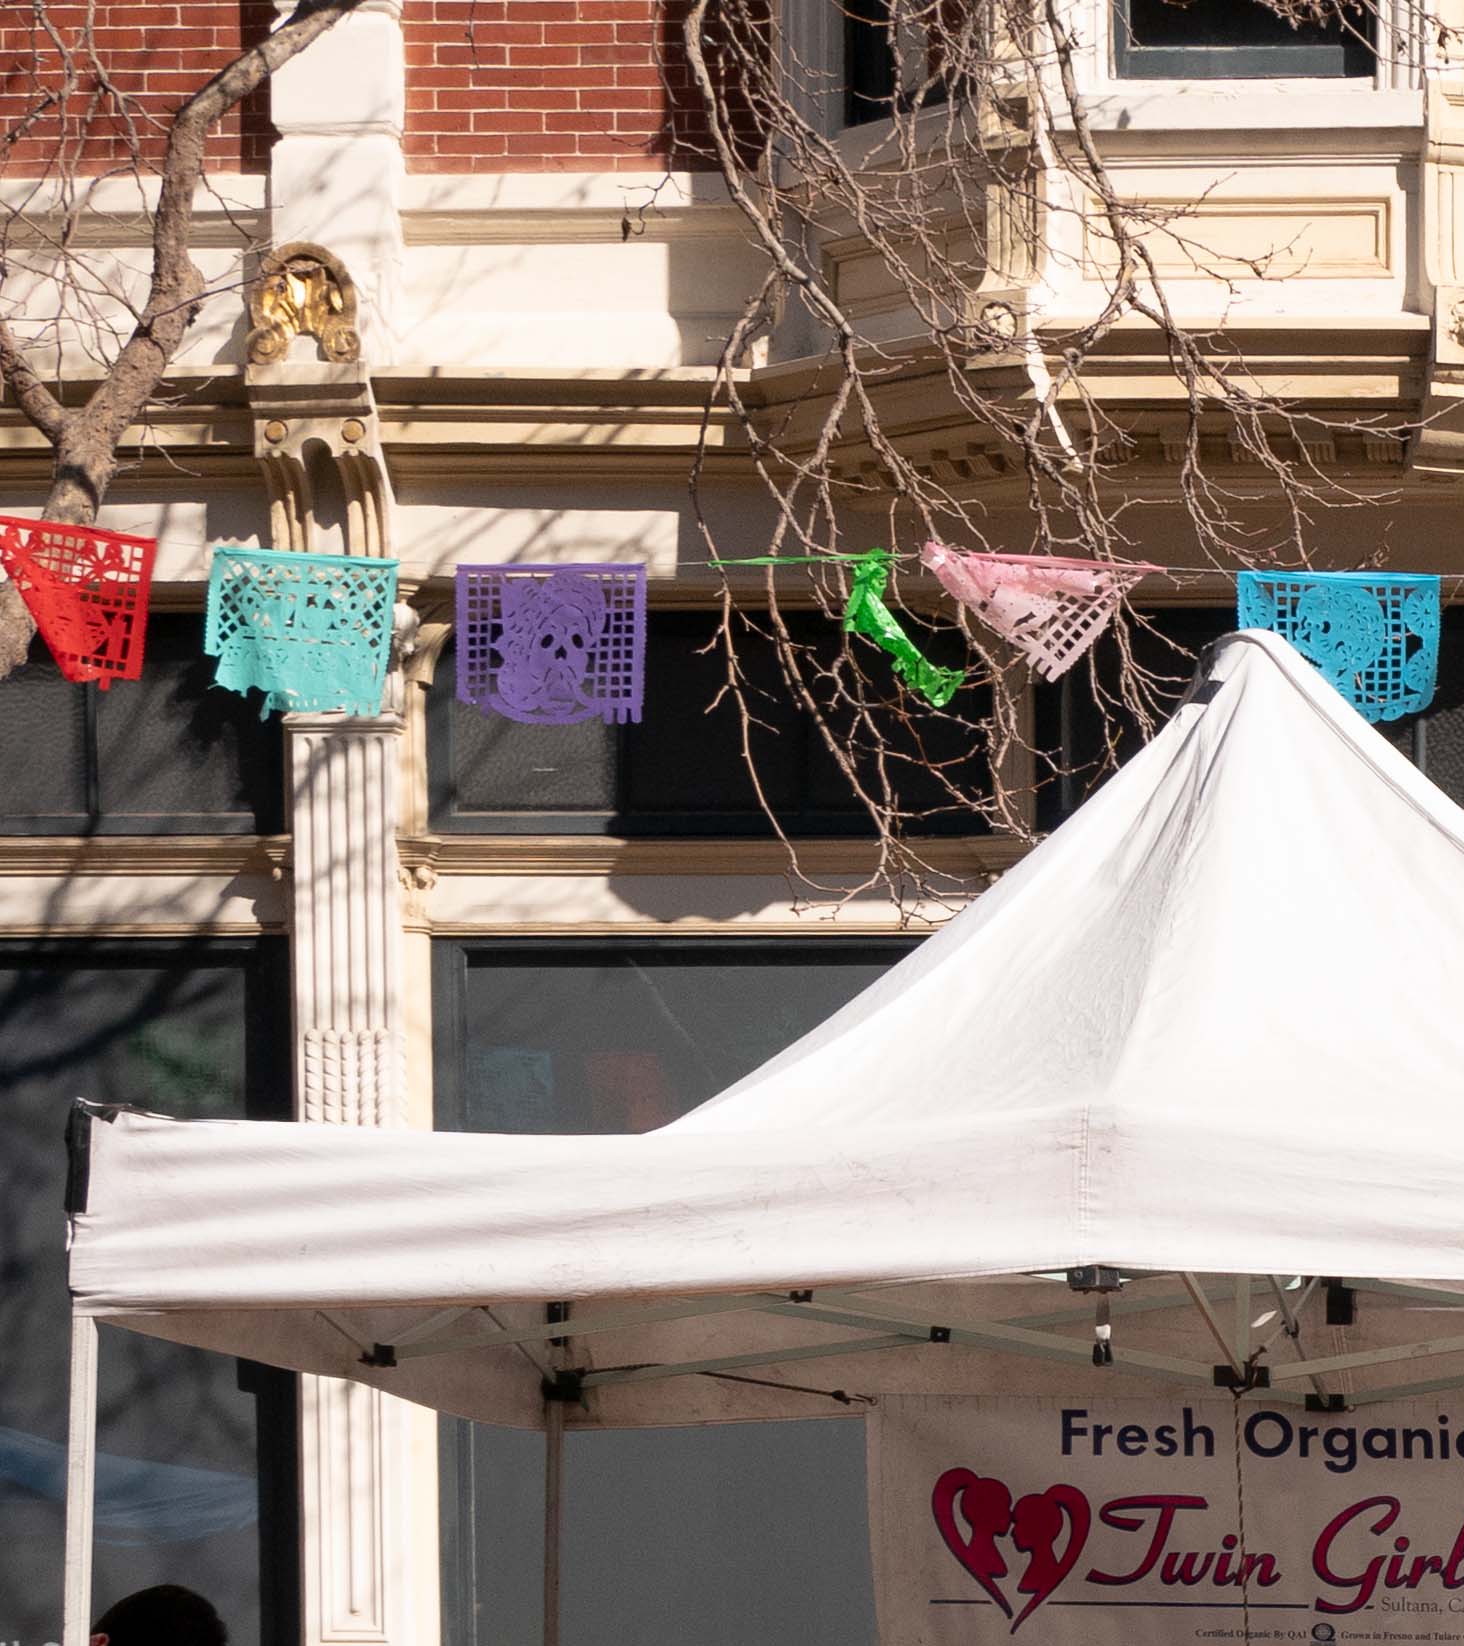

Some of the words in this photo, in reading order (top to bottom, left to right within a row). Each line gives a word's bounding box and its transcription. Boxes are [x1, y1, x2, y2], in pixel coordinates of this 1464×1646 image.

[1061, 1408, 1215, 1459] Fresh
[1087, 1493, 1282, 1589] Twin
[1380, 1596, 1443, 1616] Sultana,
[1195, 1628, 1234, 1639] Certified
[1274, 1629, 1286, 1641] By
[1340, 1630, 1370, 1640] Grown
[1372, 1630, 1382, 1641] in
[1384, 1631, 1413, 1641] Fresno
[1415, 1631, 1431, 1641] and
[1433, 1631, 1461, 1642] Tulare
